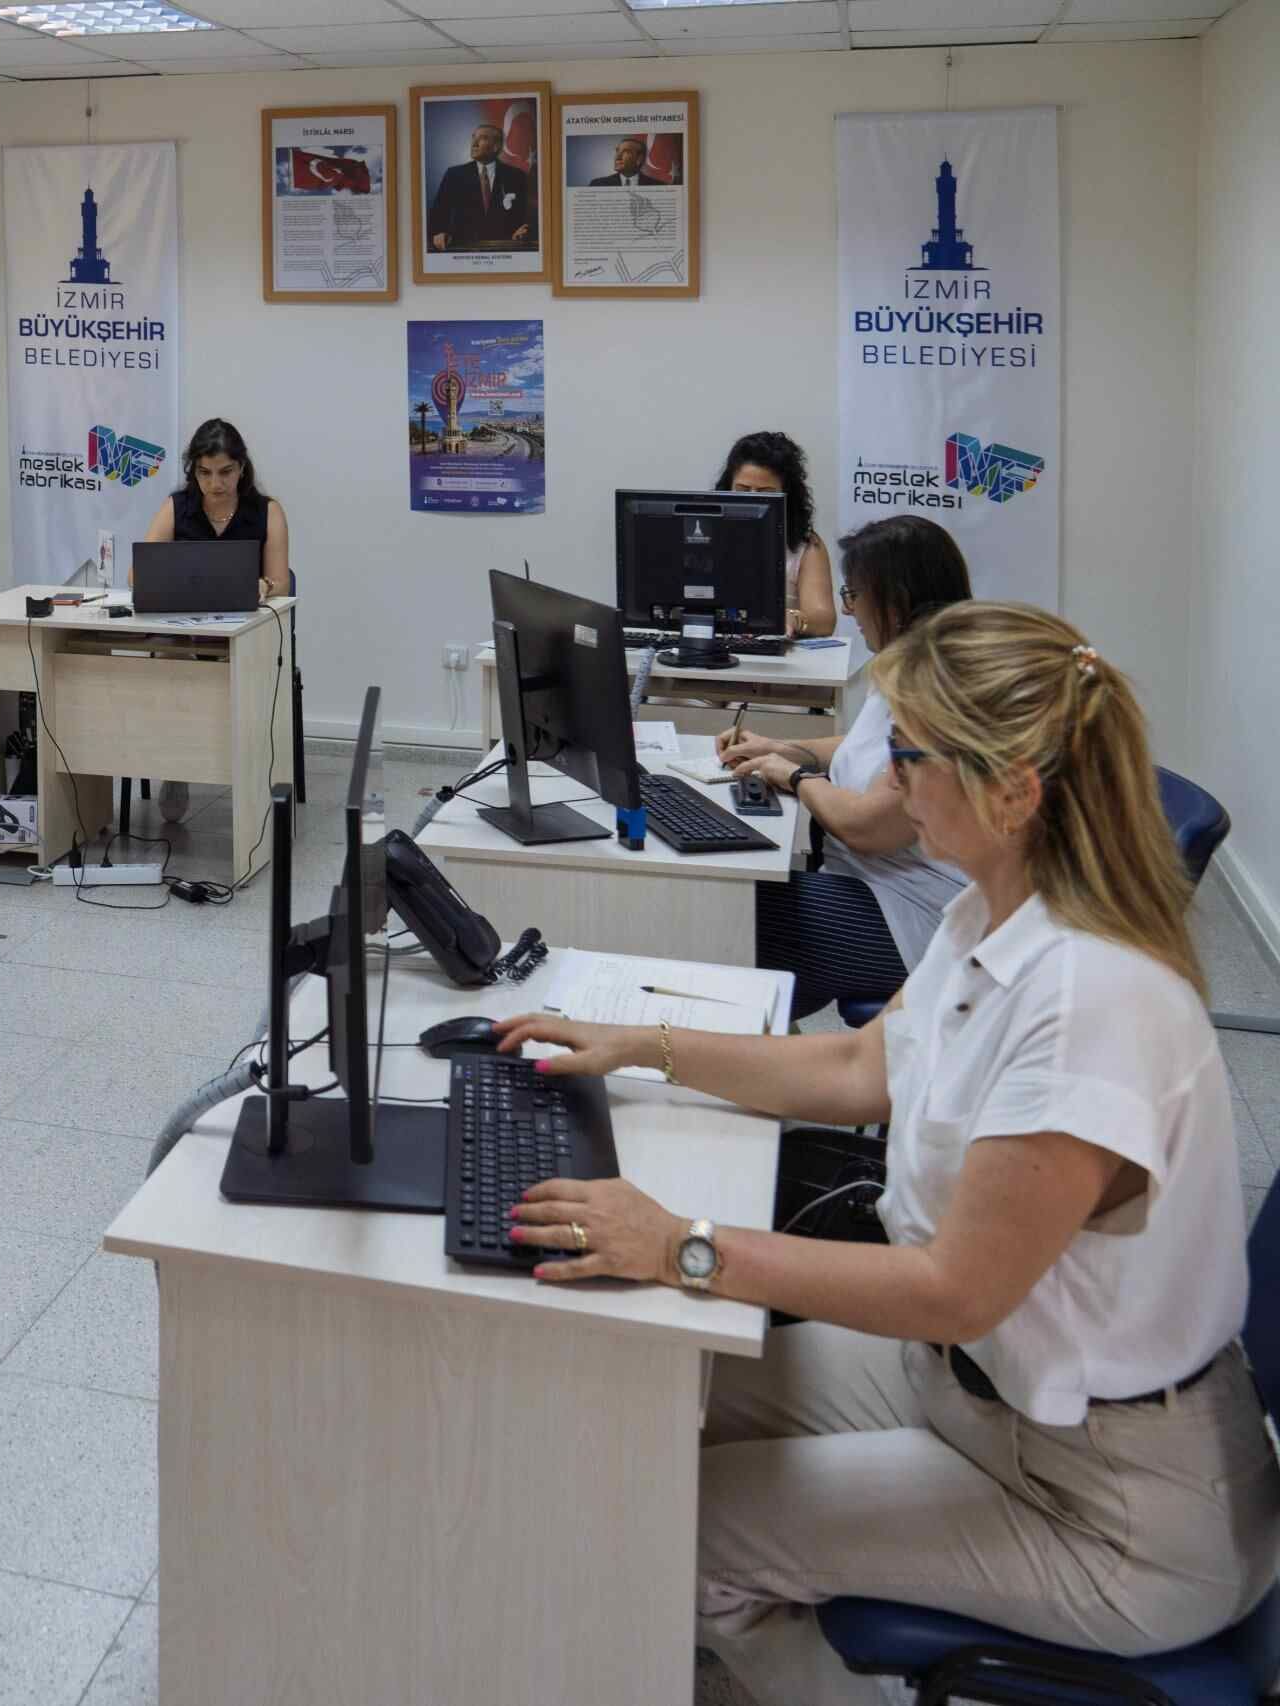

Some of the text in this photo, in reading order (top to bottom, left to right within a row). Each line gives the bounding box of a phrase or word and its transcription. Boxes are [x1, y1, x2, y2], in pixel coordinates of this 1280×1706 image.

[56, 287, 125, 310] İZMİR
[904, 274, 991, 300] İZMİR
[19, 313, 165, 342] BÜYÜKŞEHİR
[855, 306, 1043, 337] BÜYÜKŞEHİR
[25, 347, 160, 370] BELEDİYESİ
[862, 343, 1037, 368] BELEDİYESİ
[19, 457, 84, 473] meslek
[20, 472, 101, 492] fabrikası
[854, 470, 940, 488] meslek
[854, 487, 962, 509] fabrikası
